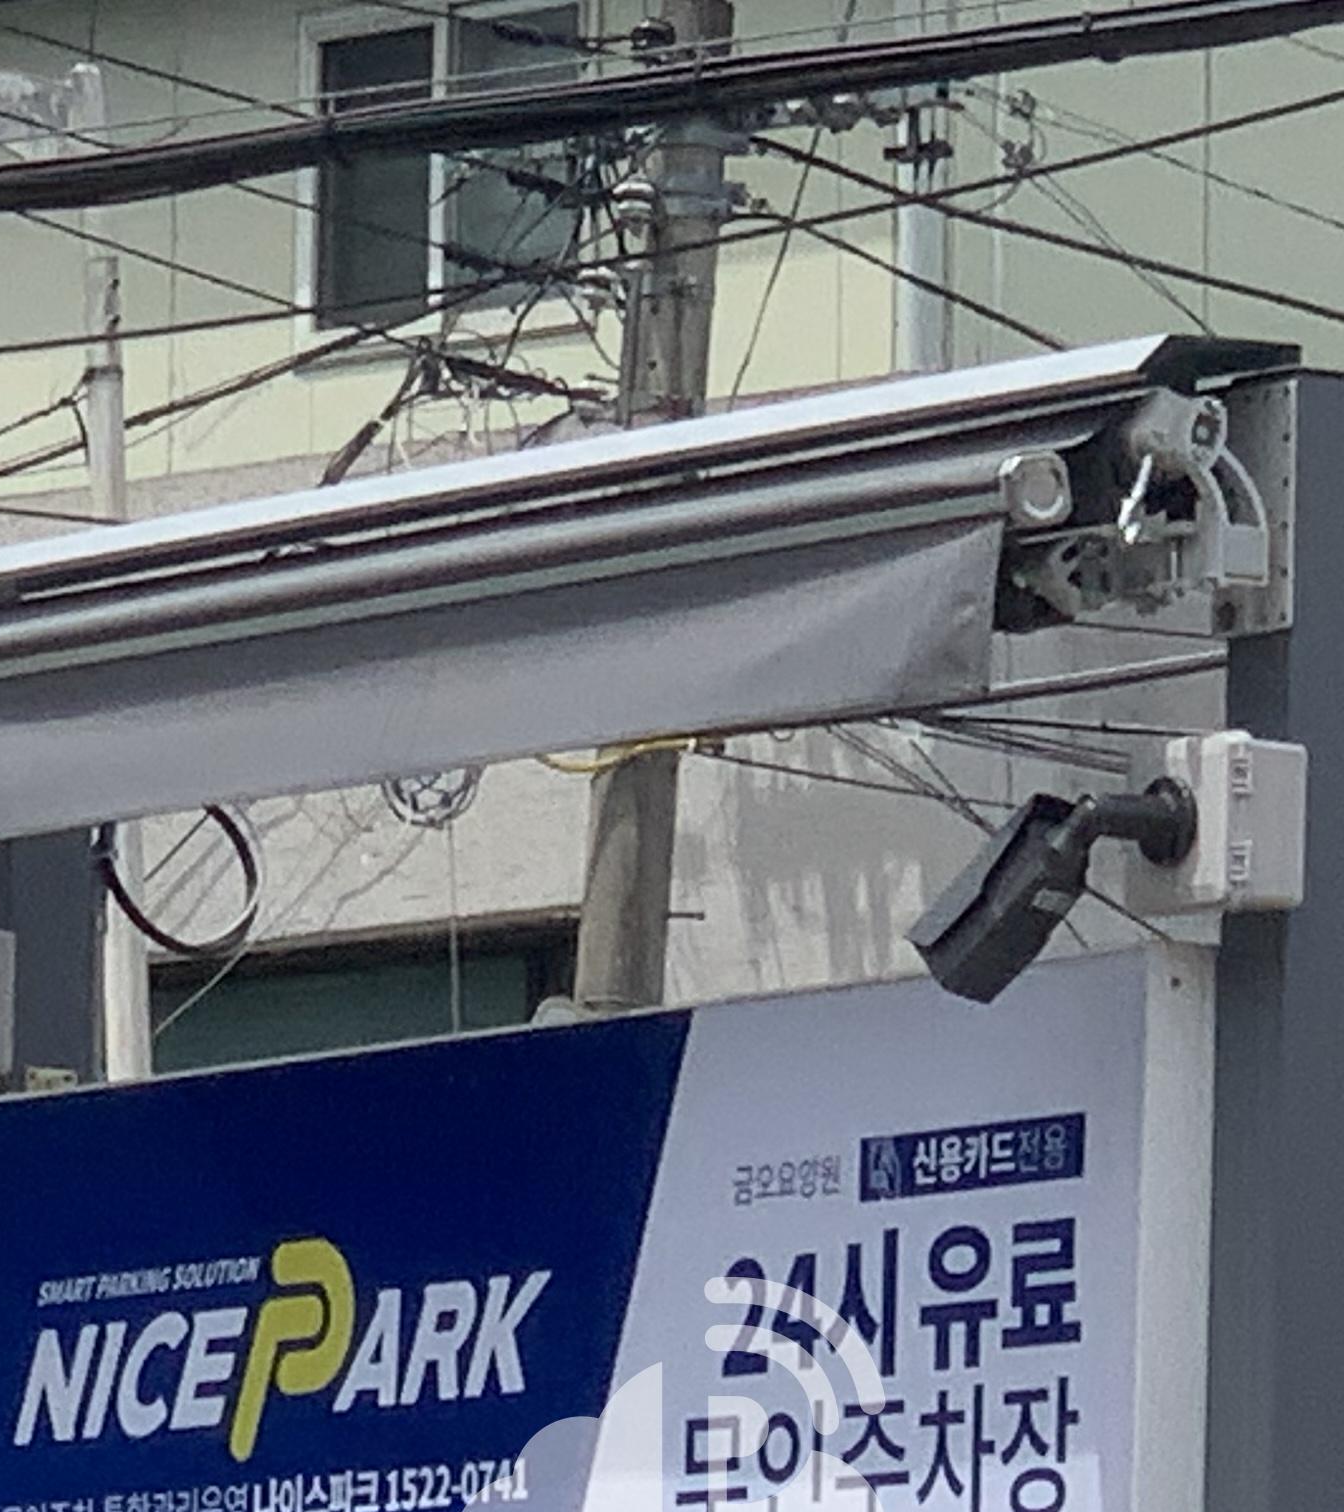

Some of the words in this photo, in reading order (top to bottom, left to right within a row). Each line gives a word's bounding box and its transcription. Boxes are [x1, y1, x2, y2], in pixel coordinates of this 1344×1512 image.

[37, 1275, 97, 1308] SMART
[94, 1266, 172, 1299] PARKING
[172, 1255, 262, 1291] SOLUTION
[721, 1227, 900, 1378] 24시
[919, 1216, 1083, 1372] 유료
